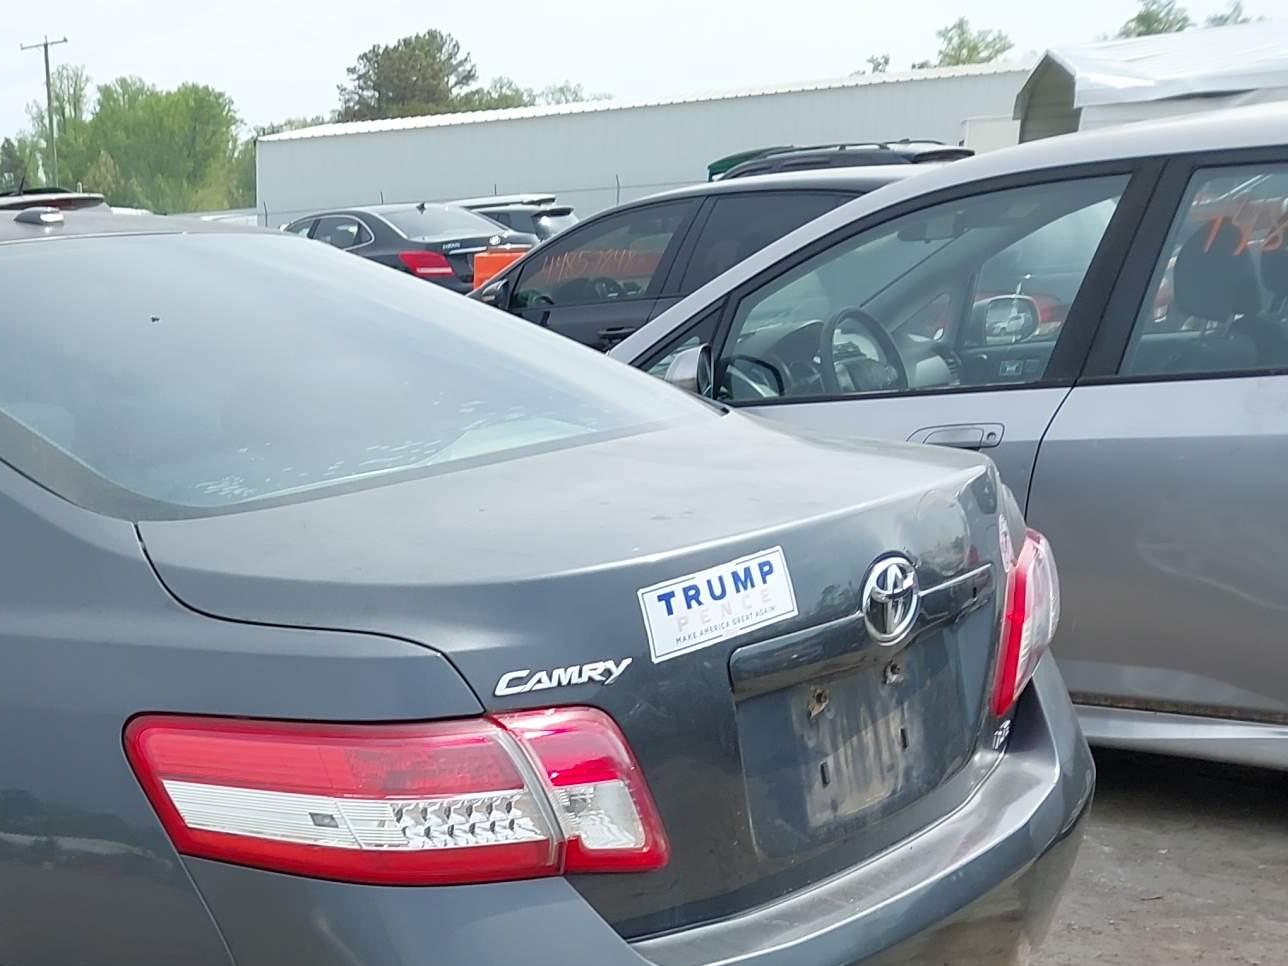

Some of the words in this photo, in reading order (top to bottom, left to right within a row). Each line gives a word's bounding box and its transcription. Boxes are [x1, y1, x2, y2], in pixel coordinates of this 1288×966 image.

[657, 560, 774, 616] TRUMP
[675, 631, 698, 645] MAKE
[699, 620, 730, 637] AMERICA
[731, 611, 754, 626] GREAT
[677, 587, 773, 633] PENCE
[494, 657, 632, 696] CAMRY
